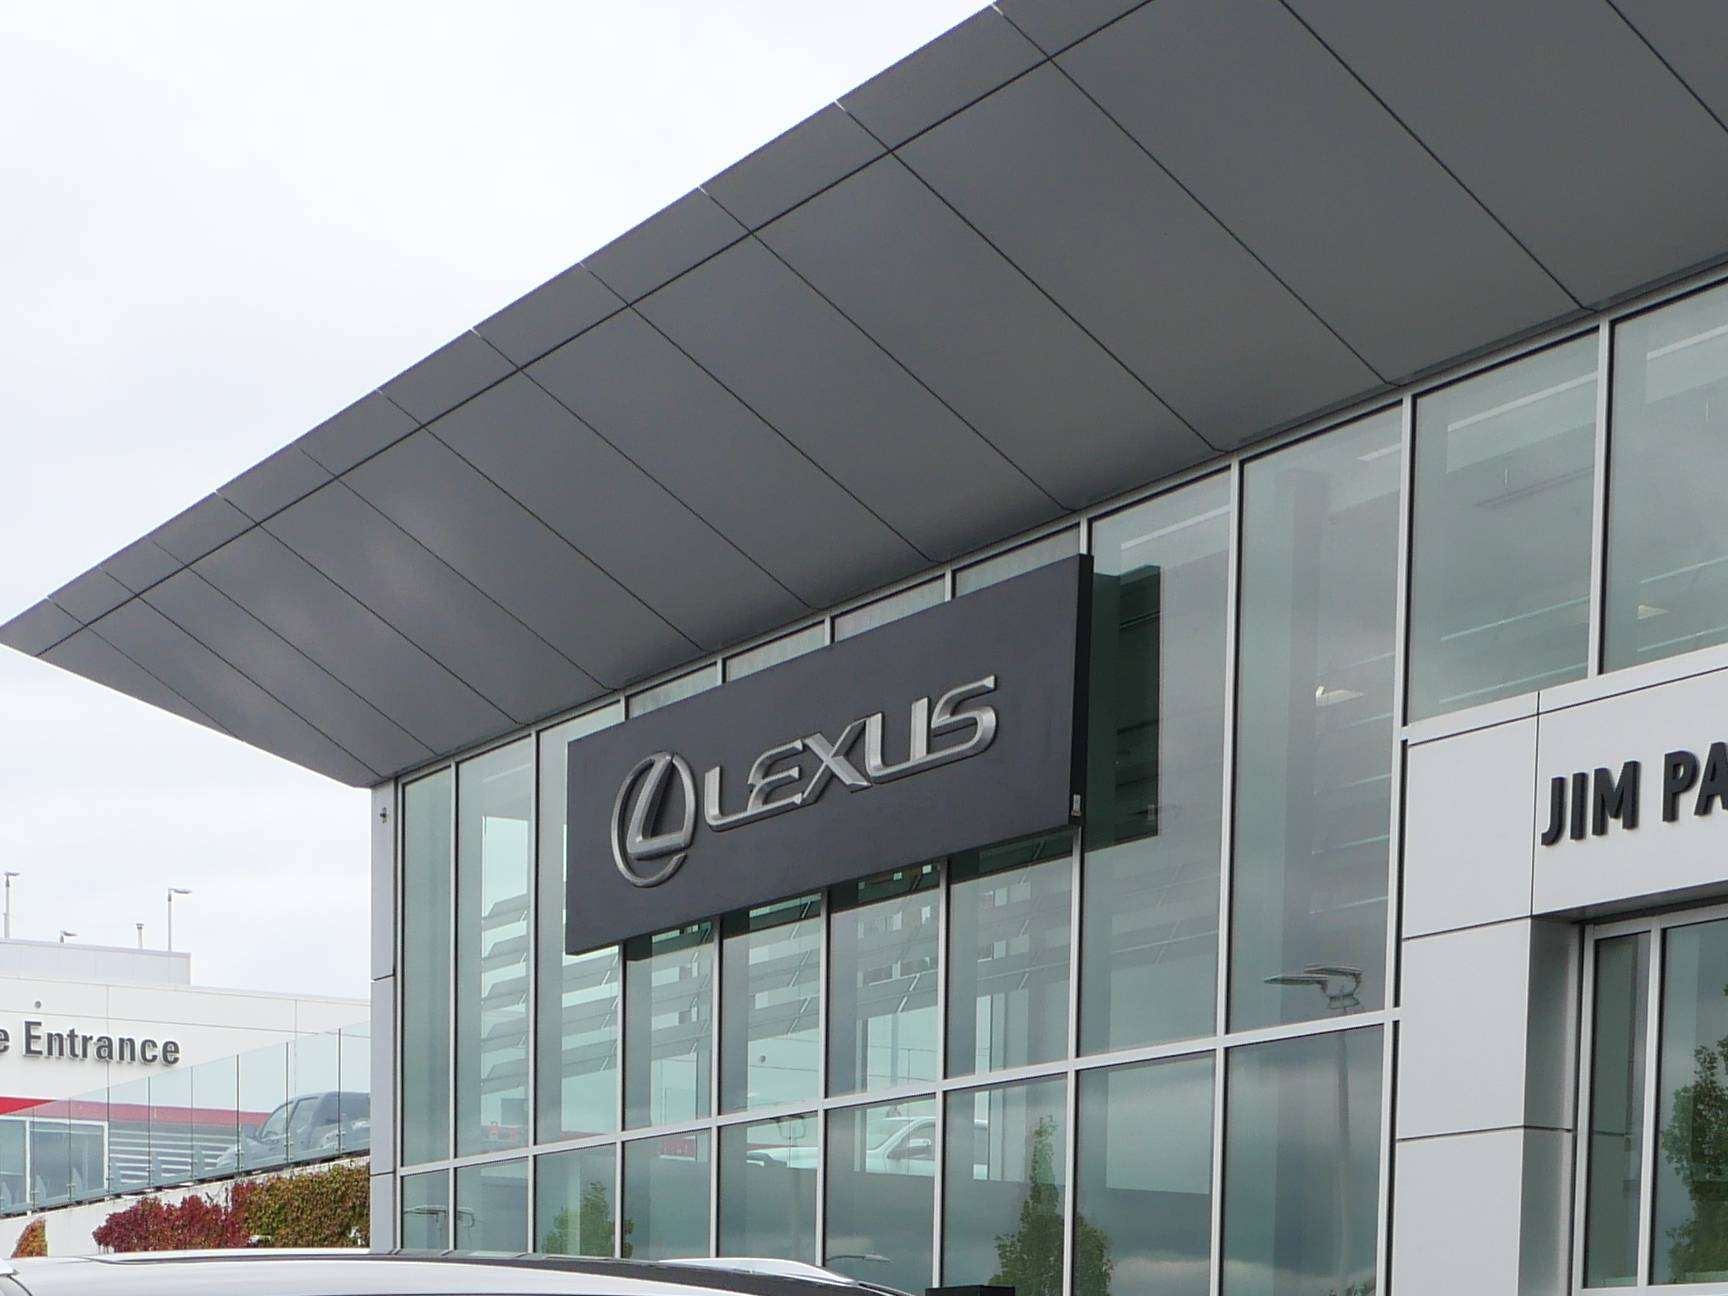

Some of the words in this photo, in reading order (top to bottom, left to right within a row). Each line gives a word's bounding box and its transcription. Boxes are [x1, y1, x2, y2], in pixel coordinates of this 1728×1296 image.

[704, 675, 997, 831] LEXUS
[1541, 759, 1641, 847] JIM
[22, 1020, 181, 1065] Entrance
